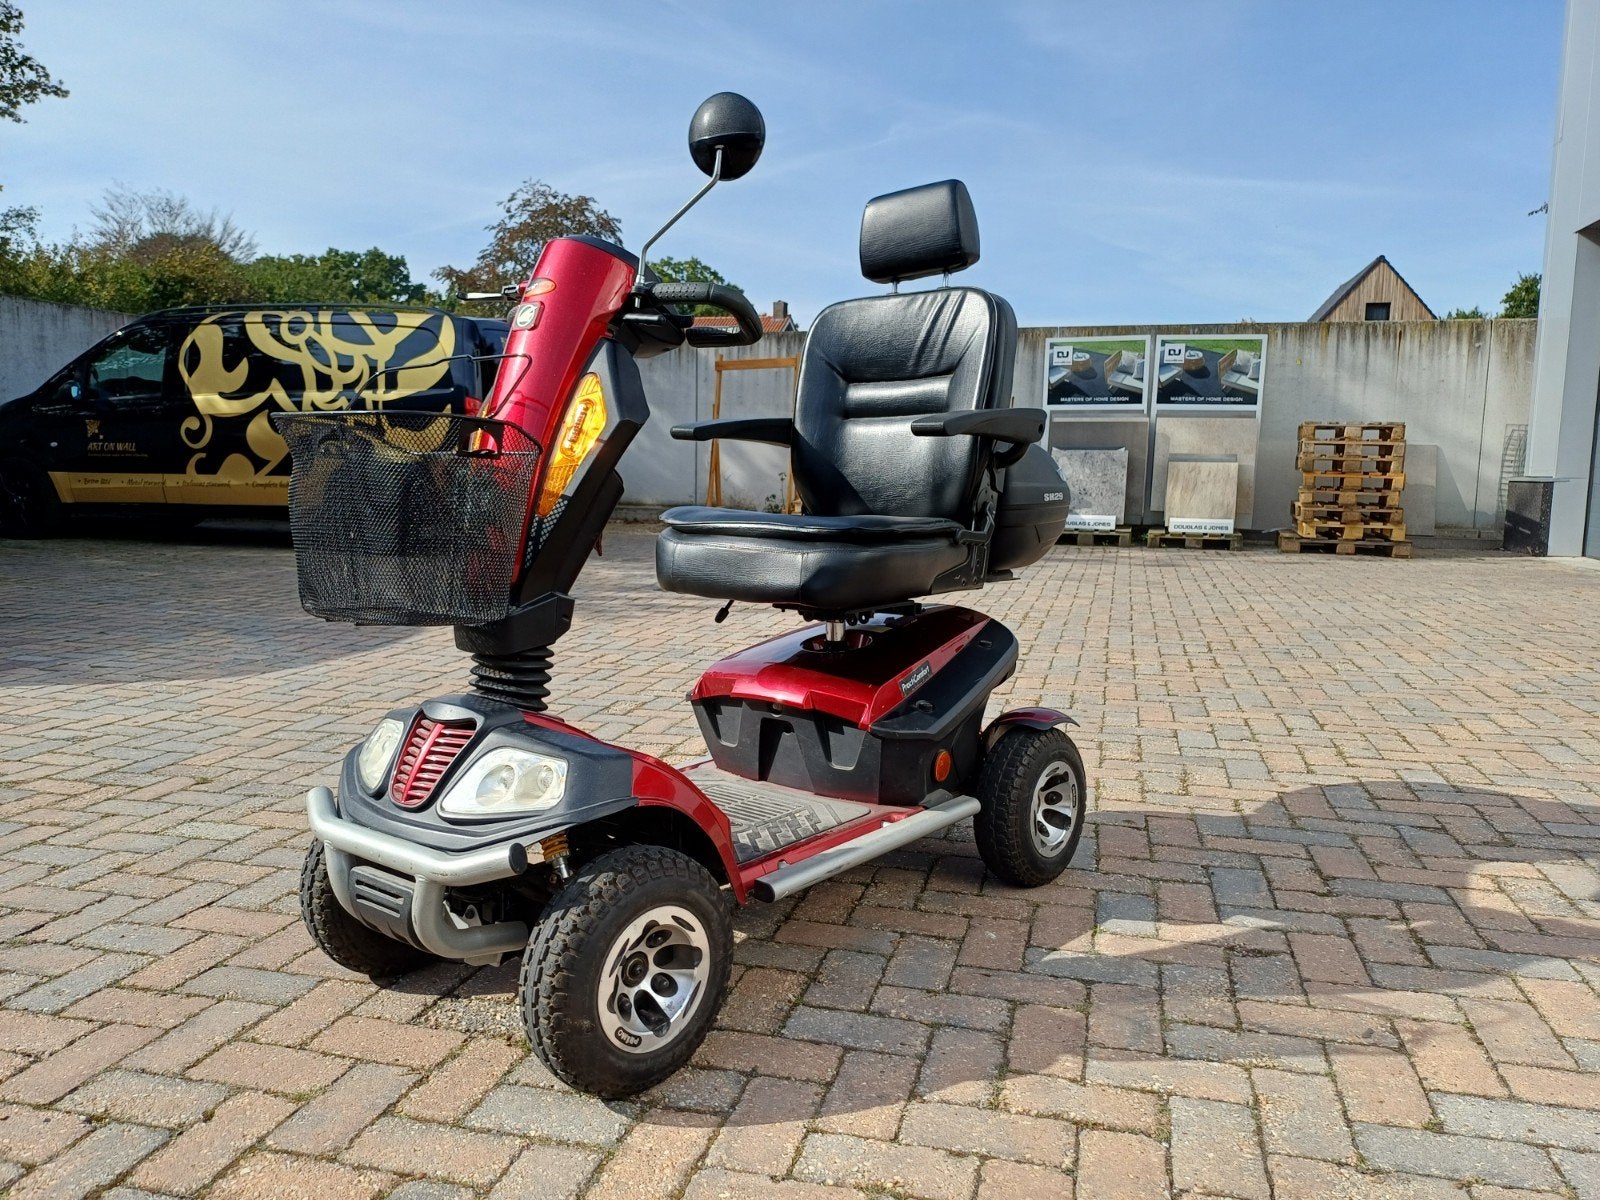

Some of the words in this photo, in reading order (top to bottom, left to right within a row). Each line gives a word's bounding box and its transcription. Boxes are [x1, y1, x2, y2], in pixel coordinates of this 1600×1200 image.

[87, 442, 102, 451] ART
[104, 442, 116, 451] ON
[117, 442, 137, 452] WALL
